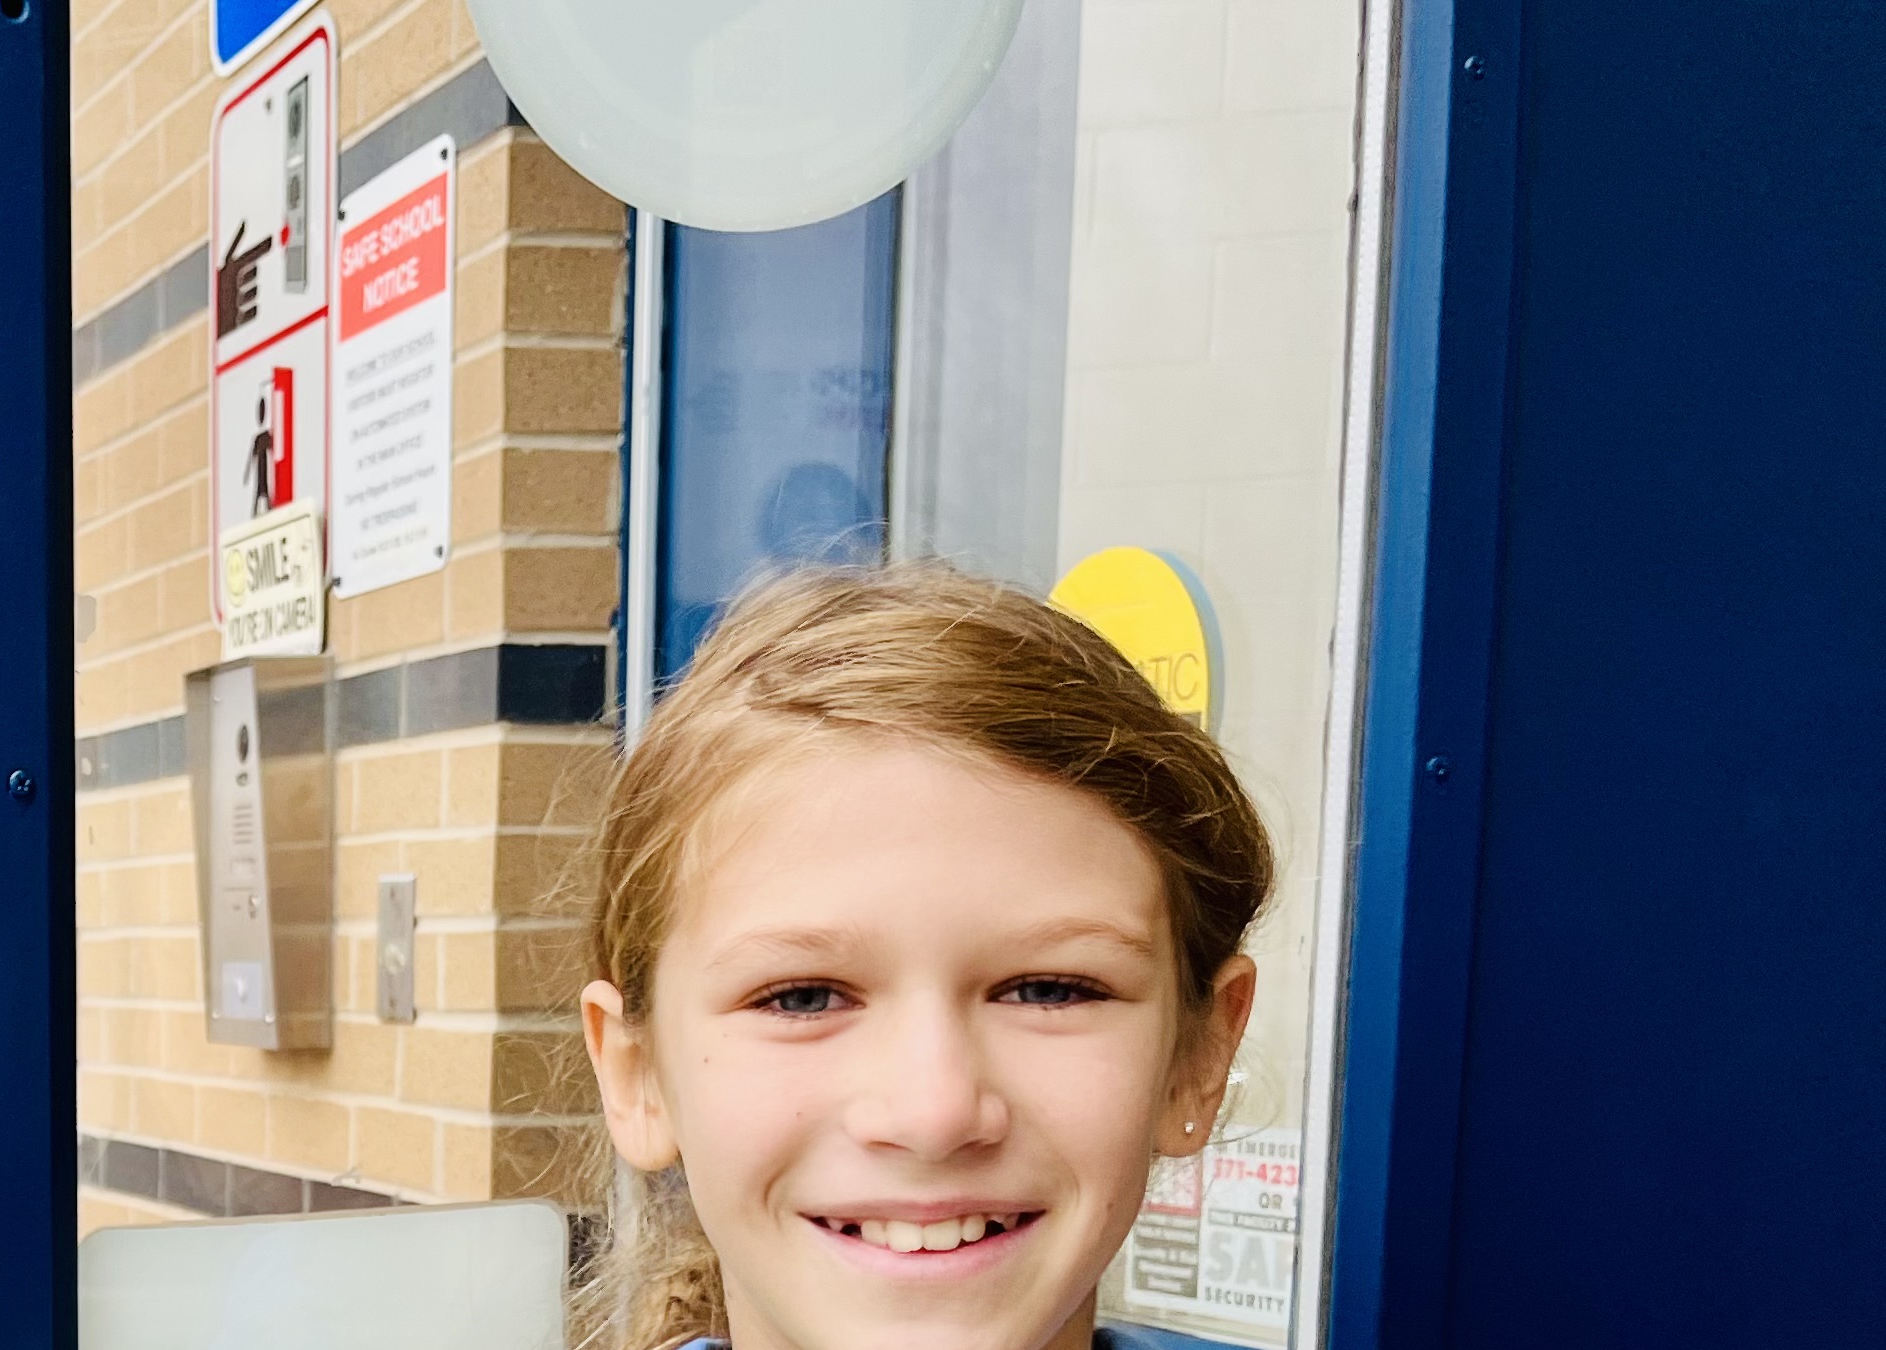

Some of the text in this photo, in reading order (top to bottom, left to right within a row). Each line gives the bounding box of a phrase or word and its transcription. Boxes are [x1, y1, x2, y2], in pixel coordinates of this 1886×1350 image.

[341, 194, 444, 278] SAFE SCHOOL
[363, 257, 419, 314] NOTICE
[246, 537, 290, 592] SMILE
[1144, 652, 1200, 701] TIC
[1204, 1286, 1285, 1313] SECURITY
